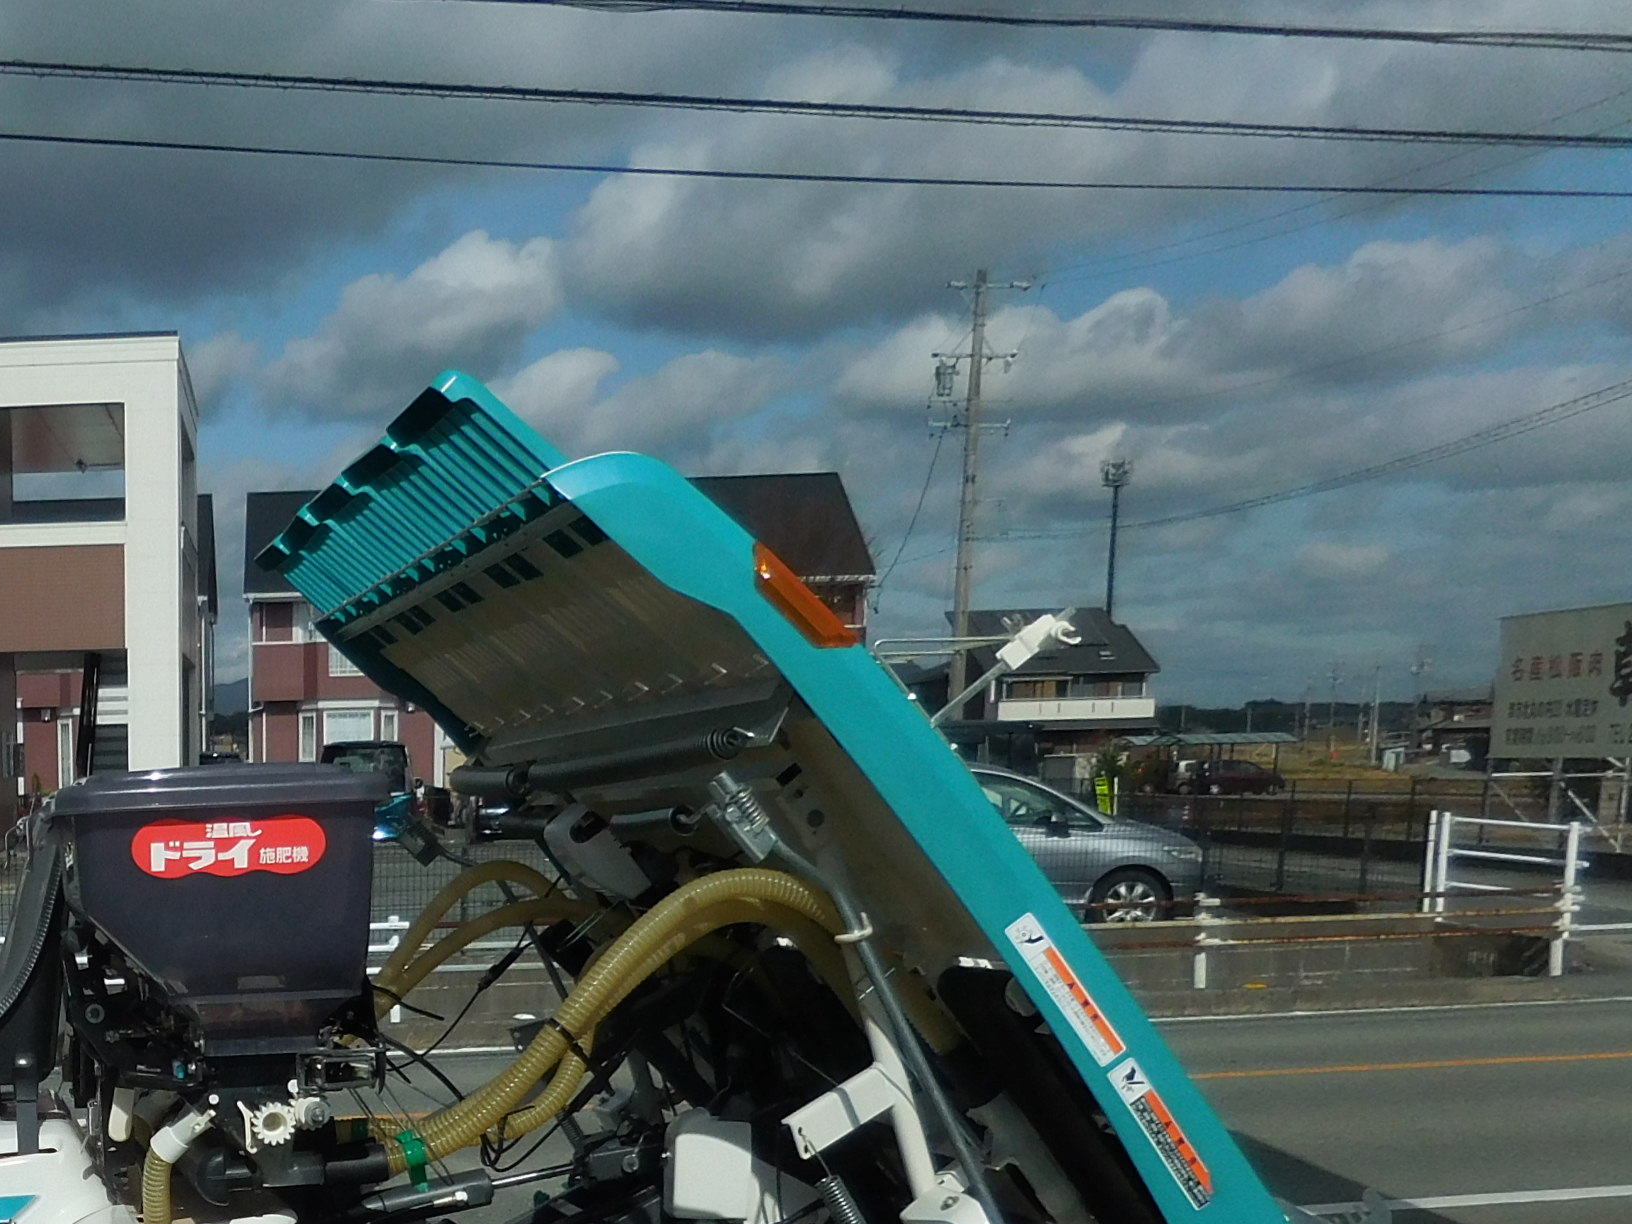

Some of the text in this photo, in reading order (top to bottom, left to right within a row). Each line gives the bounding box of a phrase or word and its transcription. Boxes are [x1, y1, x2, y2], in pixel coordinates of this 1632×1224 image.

[205, 822, 262, 838] 温風
[150, 839, 309, 872] ドライ 施肥機
